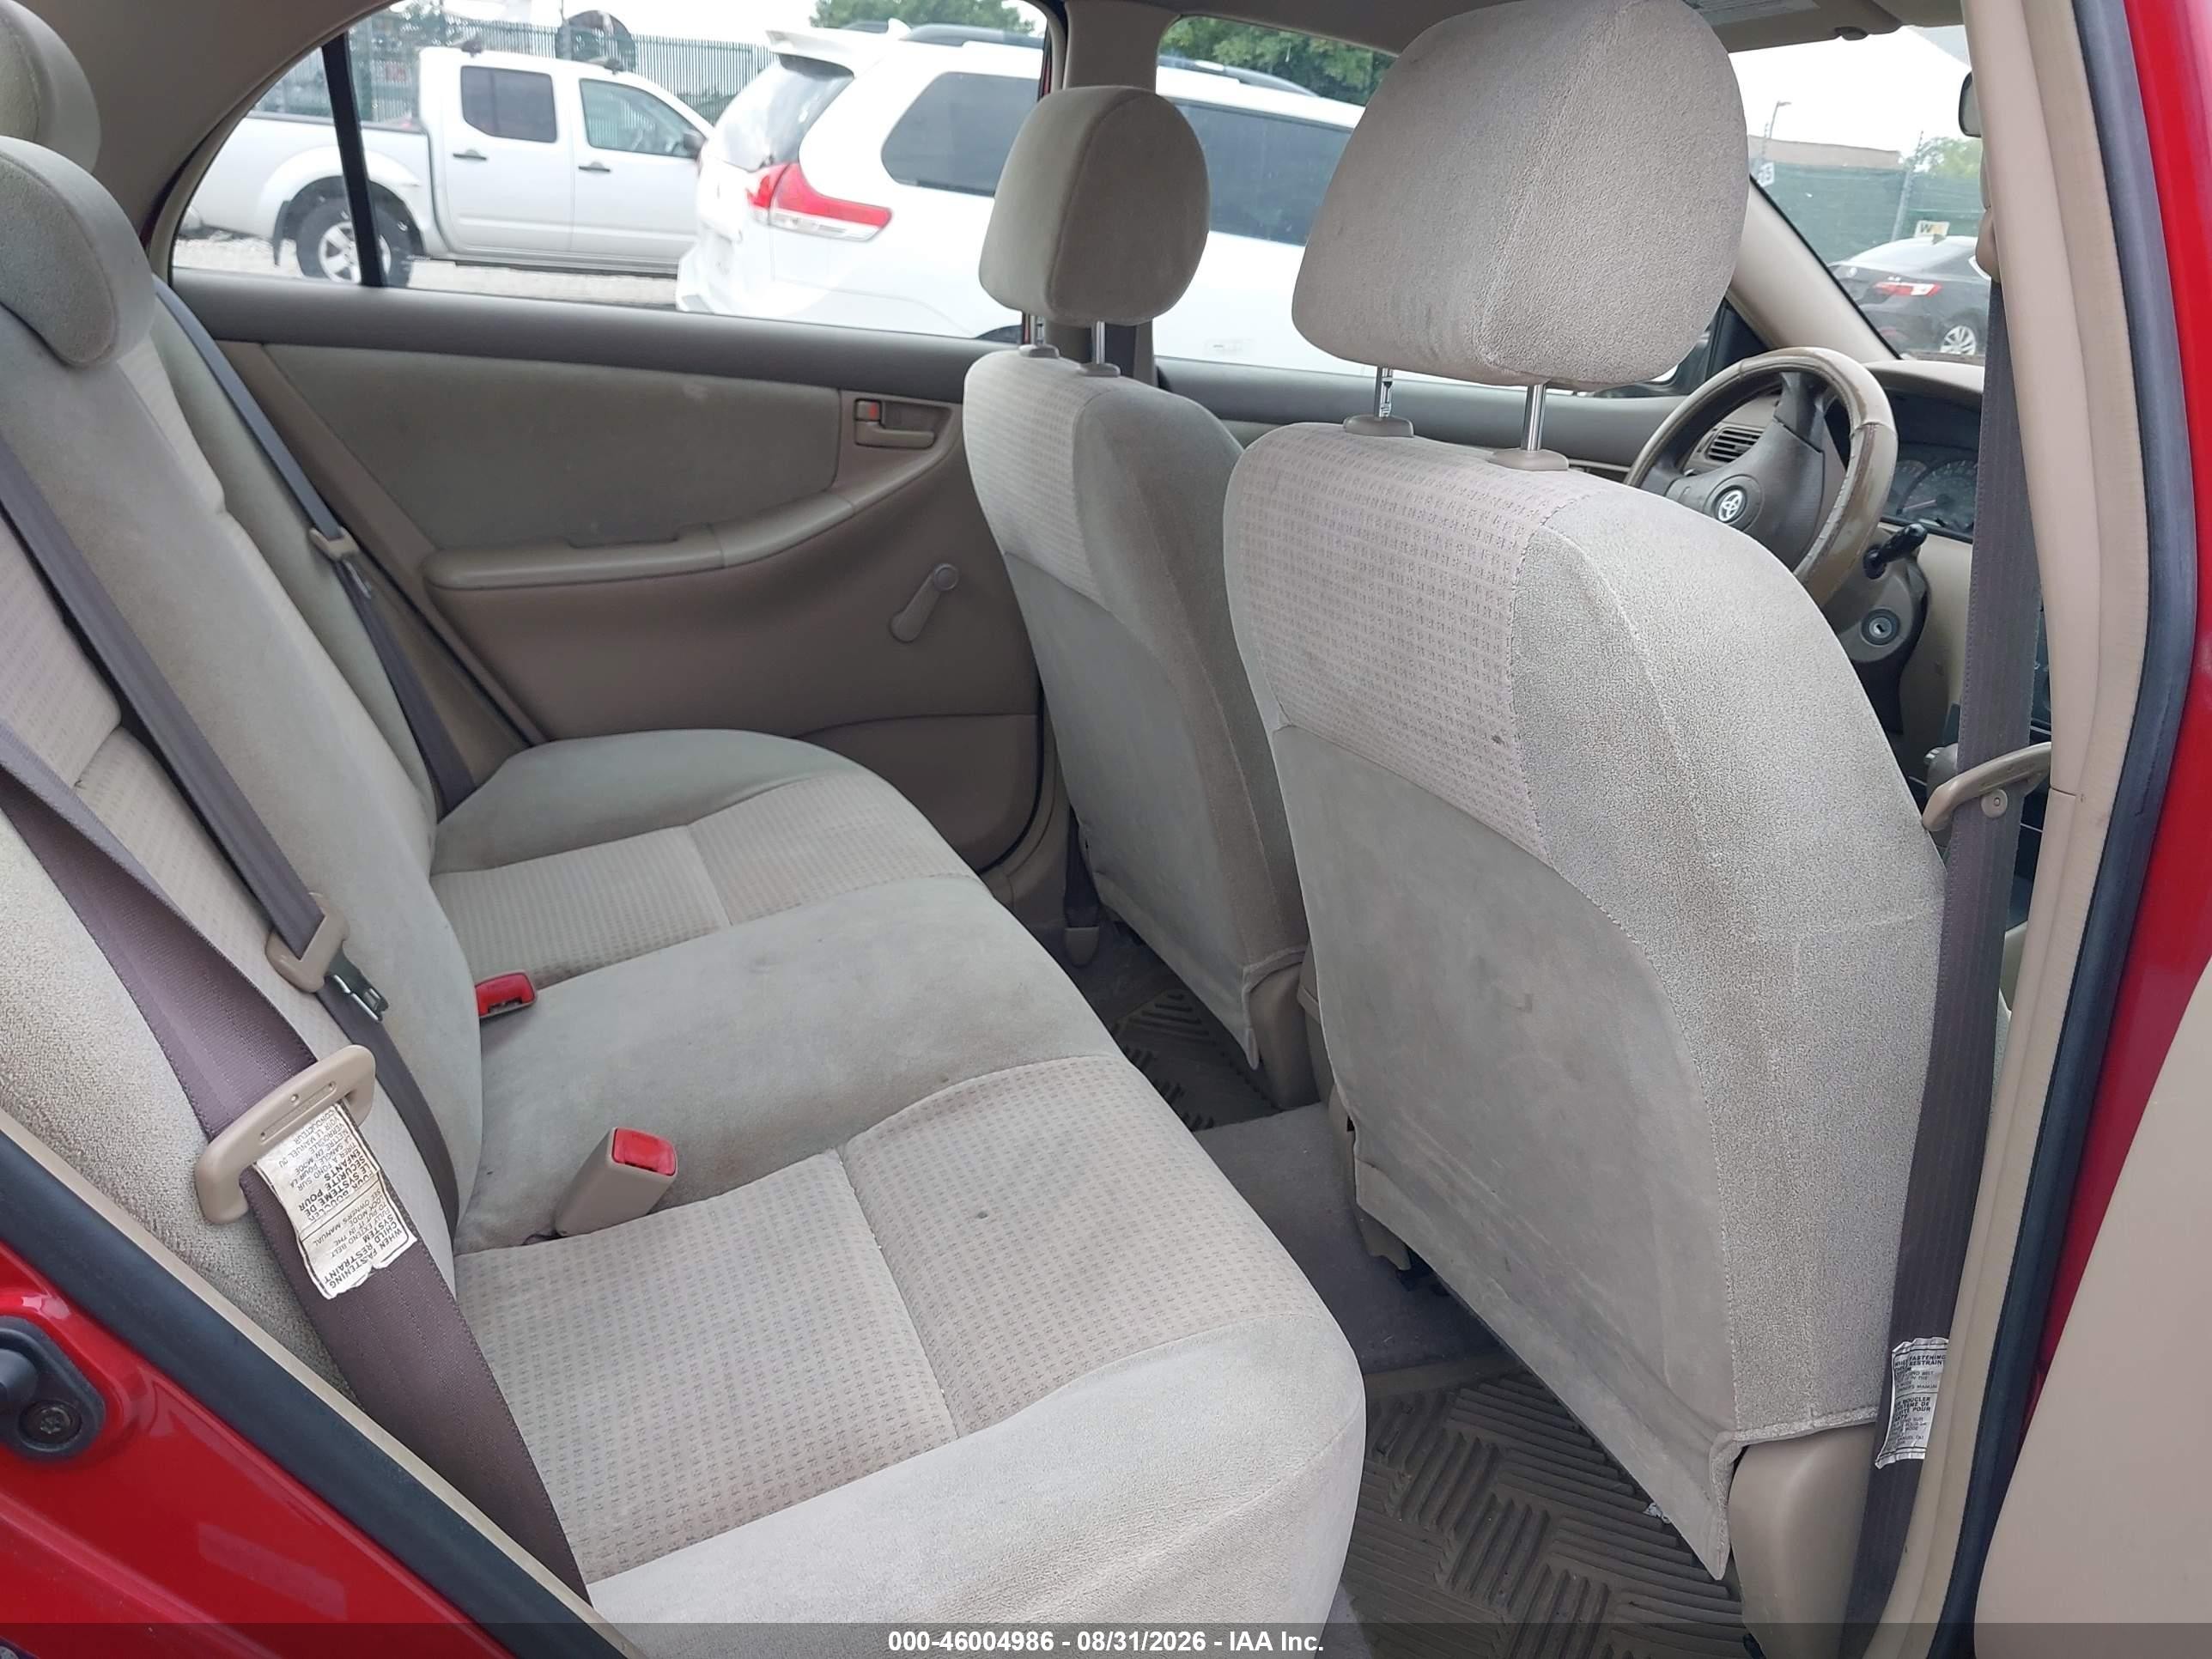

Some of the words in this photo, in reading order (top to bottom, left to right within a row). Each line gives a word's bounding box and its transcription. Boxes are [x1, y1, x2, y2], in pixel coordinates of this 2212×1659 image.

[324, 1115, 339, 1131] VOIR
[315, 1128, 324, 1138] LE
[325, 1128, 348, 1150] METTRE
[288, 1135, 315, 1159] MANUEL
[314, 1148, 324, 1158] EN
[318, 1143, 343, 1165] SANGLE
[338, 1142, 356, 1158] TIRER
[294, 1157, 313, 1174] MODE
[299, 1163, 318, 1180] POUR
[313, 1162, 331, 1178] FOND
[323, 1148, 360, 1181] ENFANTS
[325, 1155, 366, 1190] SECURITE
[359, 1162, 369, 1174] LE
[289, 1178, 298, 1188] LA
[296, 1176, 313, 1191] SUR
[318, 1171, 360, 1206] SYSTEME
[297, 1188, 323, 1211] POUR
[368, 1194, 383, 1210] LOCK
[370, 1188, 380, 1200] SEE
[303, 1204, 317, 1217] DE
[343, 1199, 370, 1224] OWNER'S
[379, 1201, 386, 1210] TO
[349, 1209, 367, 1226] MODE
[365, 1209, 378, 1221] PUT
[347, 1222, 372, 1244] EXTEND
[356, 1220, 364, 1229] IT
[362, 1213, 393, 1243] SYSTEM
[373, 1220, 398, 1243] CHILD
[312, 1222, 341, 1246] MANUAL
[333, 1234, 346, 1246] THE
[378, 1228, 401, 1249] WHEN
[330, 1243, 346, 1257] BELT
[323, 1242, 373, 1284] RESTRAINT
[328, 1248, 378, 1289] FASTENING
